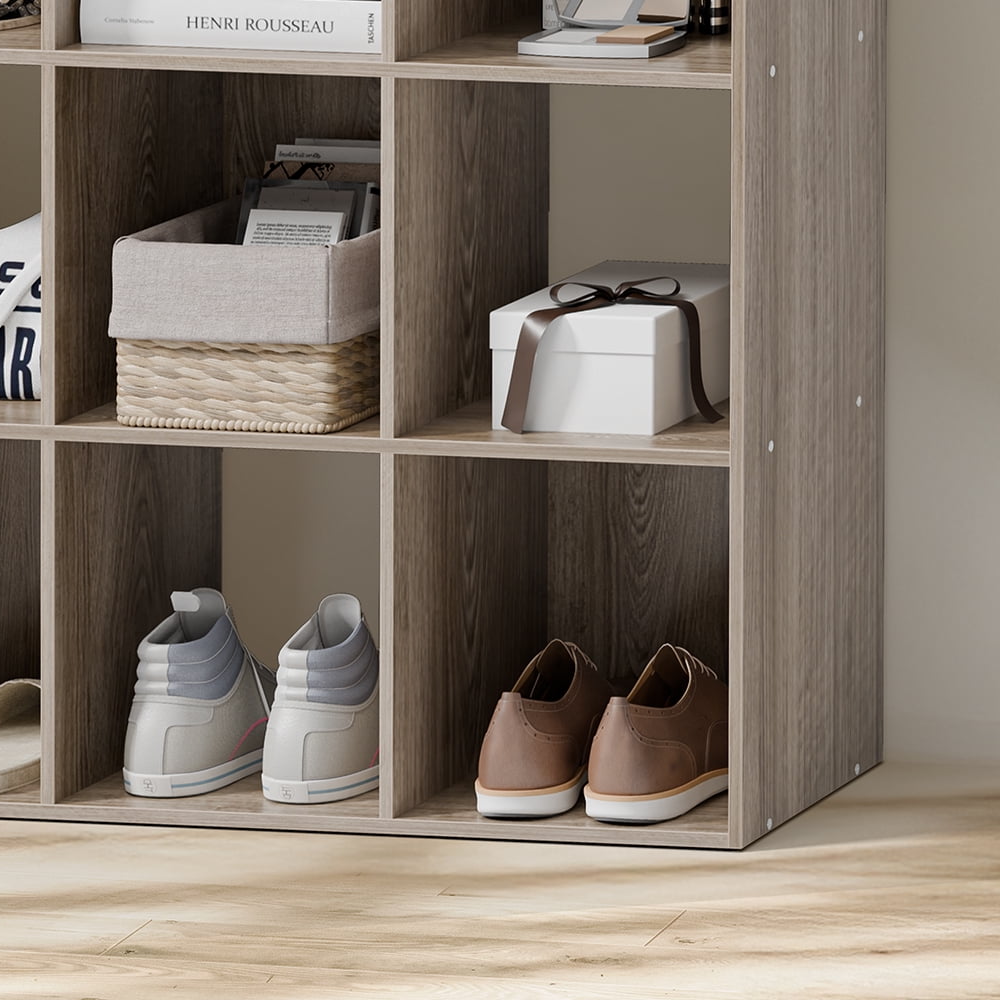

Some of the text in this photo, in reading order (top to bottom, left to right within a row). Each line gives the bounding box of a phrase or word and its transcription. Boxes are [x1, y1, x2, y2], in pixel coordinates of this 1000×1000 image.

[186, 16, 335, 34] HENRI ROUSSEAU
[367, 13, 375, 44] TASCHEN
